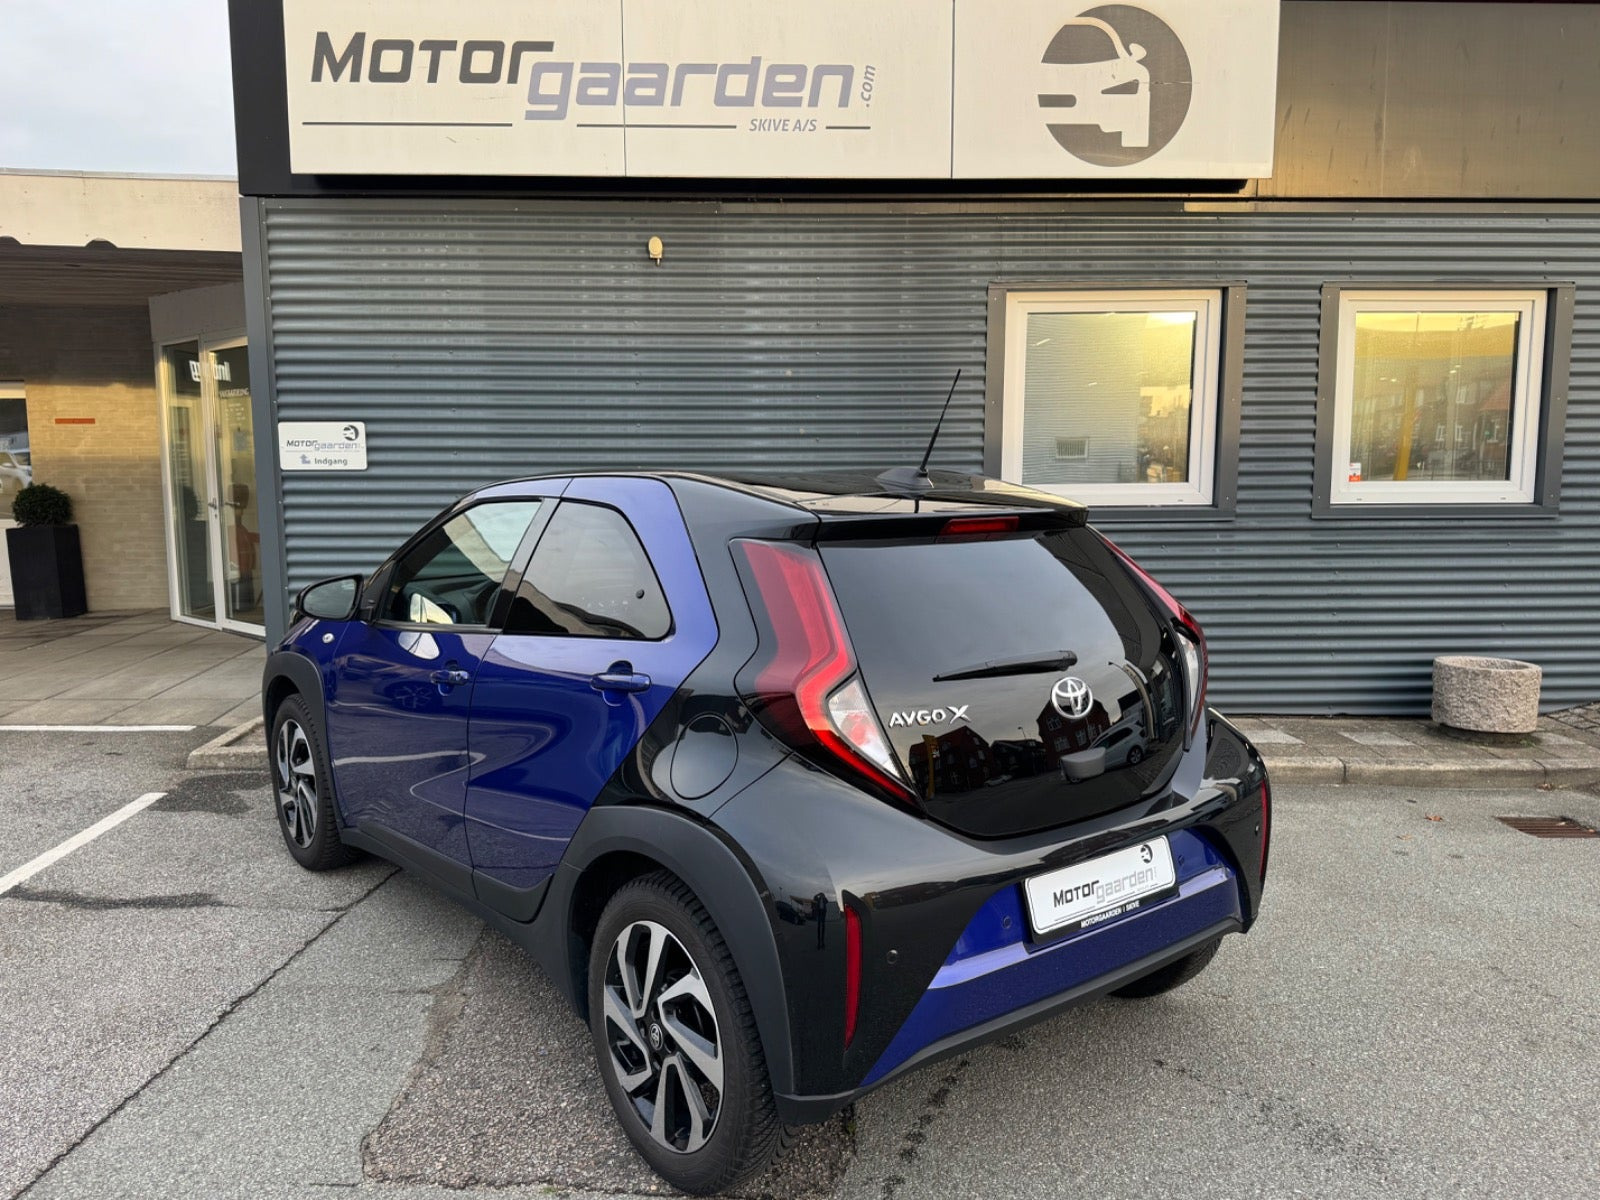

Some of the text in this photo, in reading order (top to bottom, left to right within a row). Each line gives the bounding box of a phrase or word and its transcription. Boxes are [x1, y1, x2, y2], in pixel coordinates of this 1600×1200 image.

[860, 65, 876, 107] .com
[749, 118, 817, 131] SKIVE A/S
[314, 458, 348, 466] Indgang
[946, 704, 972, 725] X
